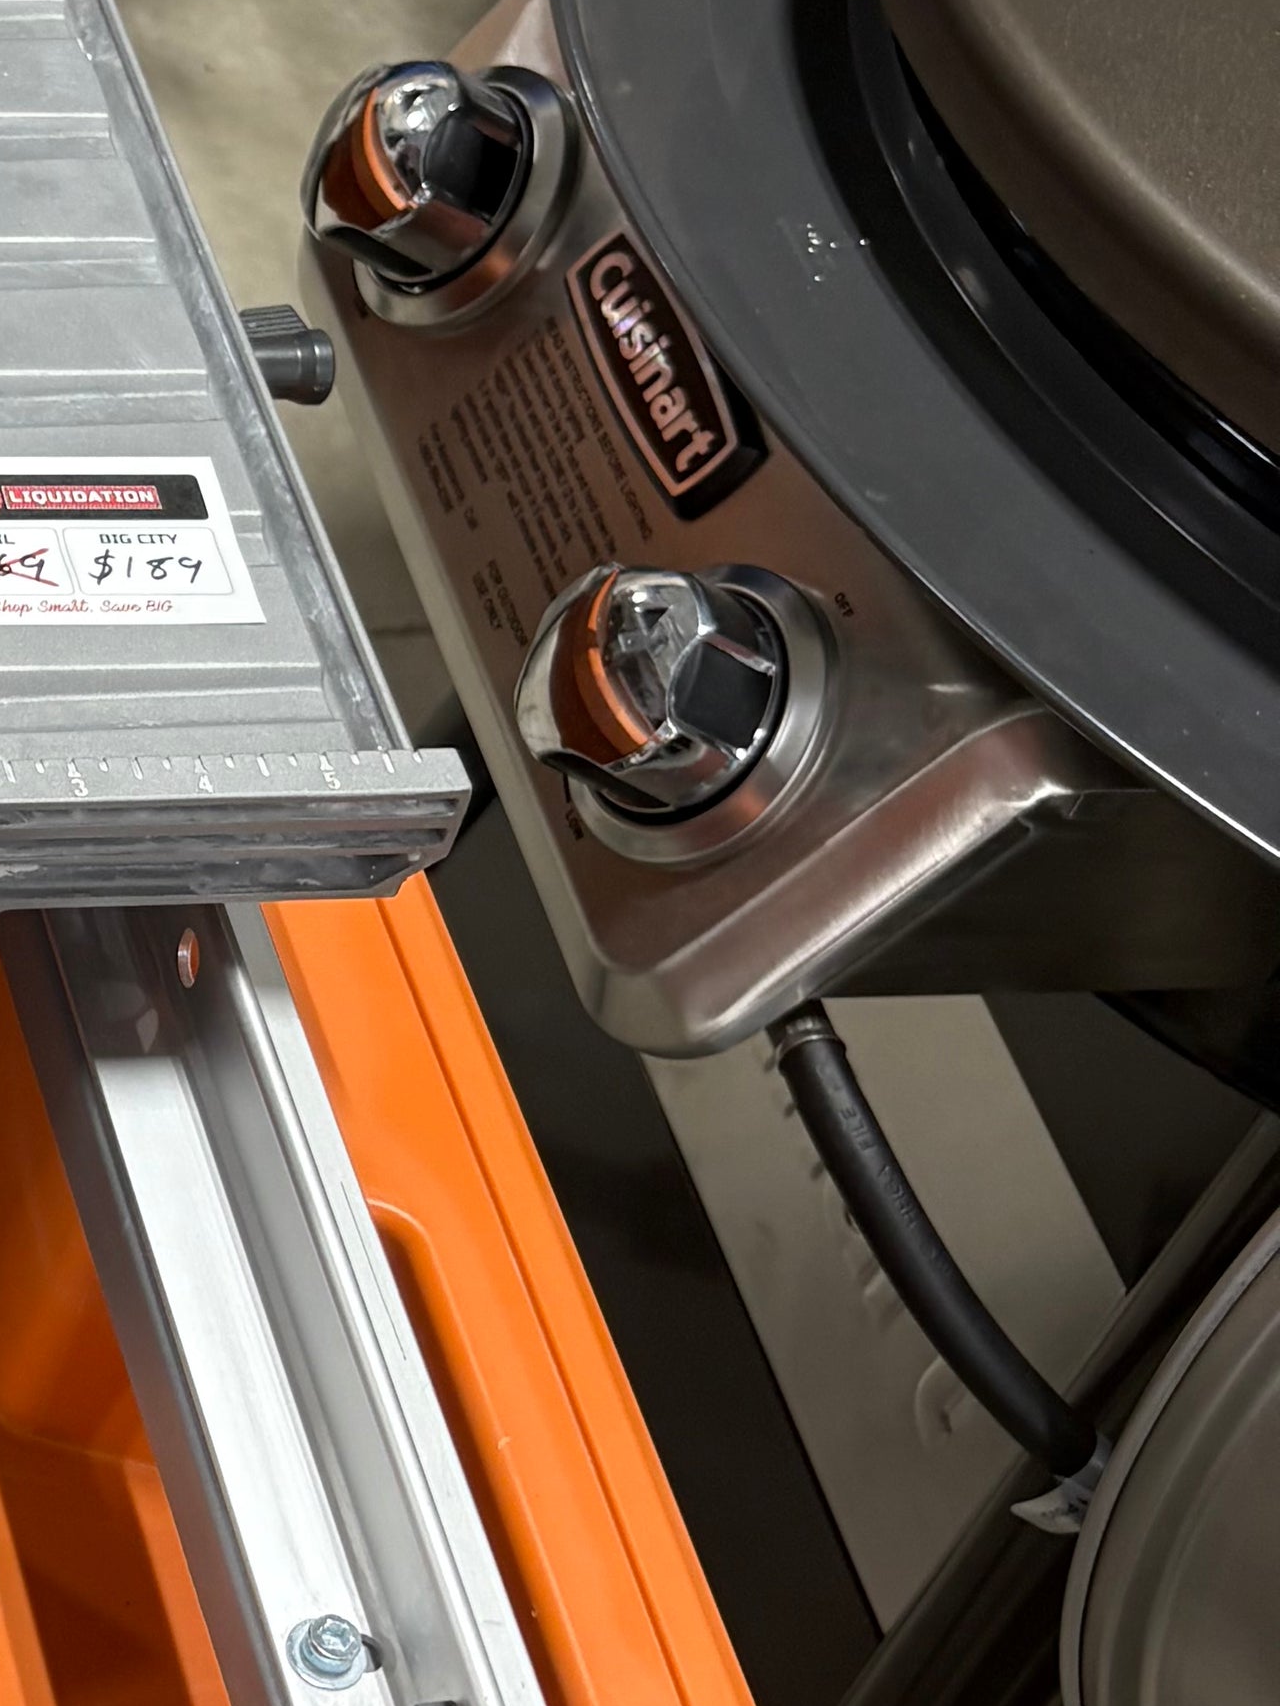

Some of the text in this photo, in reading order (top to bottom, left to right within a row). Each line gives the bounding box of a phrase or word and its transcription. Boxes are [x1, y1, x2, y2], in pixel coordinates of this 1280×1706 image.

[571, 245, 730, 474] Cuisinart
[556, 347, 605, 432] INSTRUCTIONS
[595, 430, 628, 481] BEFORE
[8, 489, 155, 505] LIQUIDATION
[99, 533, 131, 544] BIG
[138, 533, 178, 544] CITY
[89, 549, 202, 584] $189
[36, 599, 93, 613] Smart.
[102, 599, 141, 612] Save
[145, 599, 173, 612] BIG
[832, 590, 855, 619] OFF
[71, 777, 89, 796] 3
[197, 773, 214, 793] 4
[323, 769, 341, 789] 5
